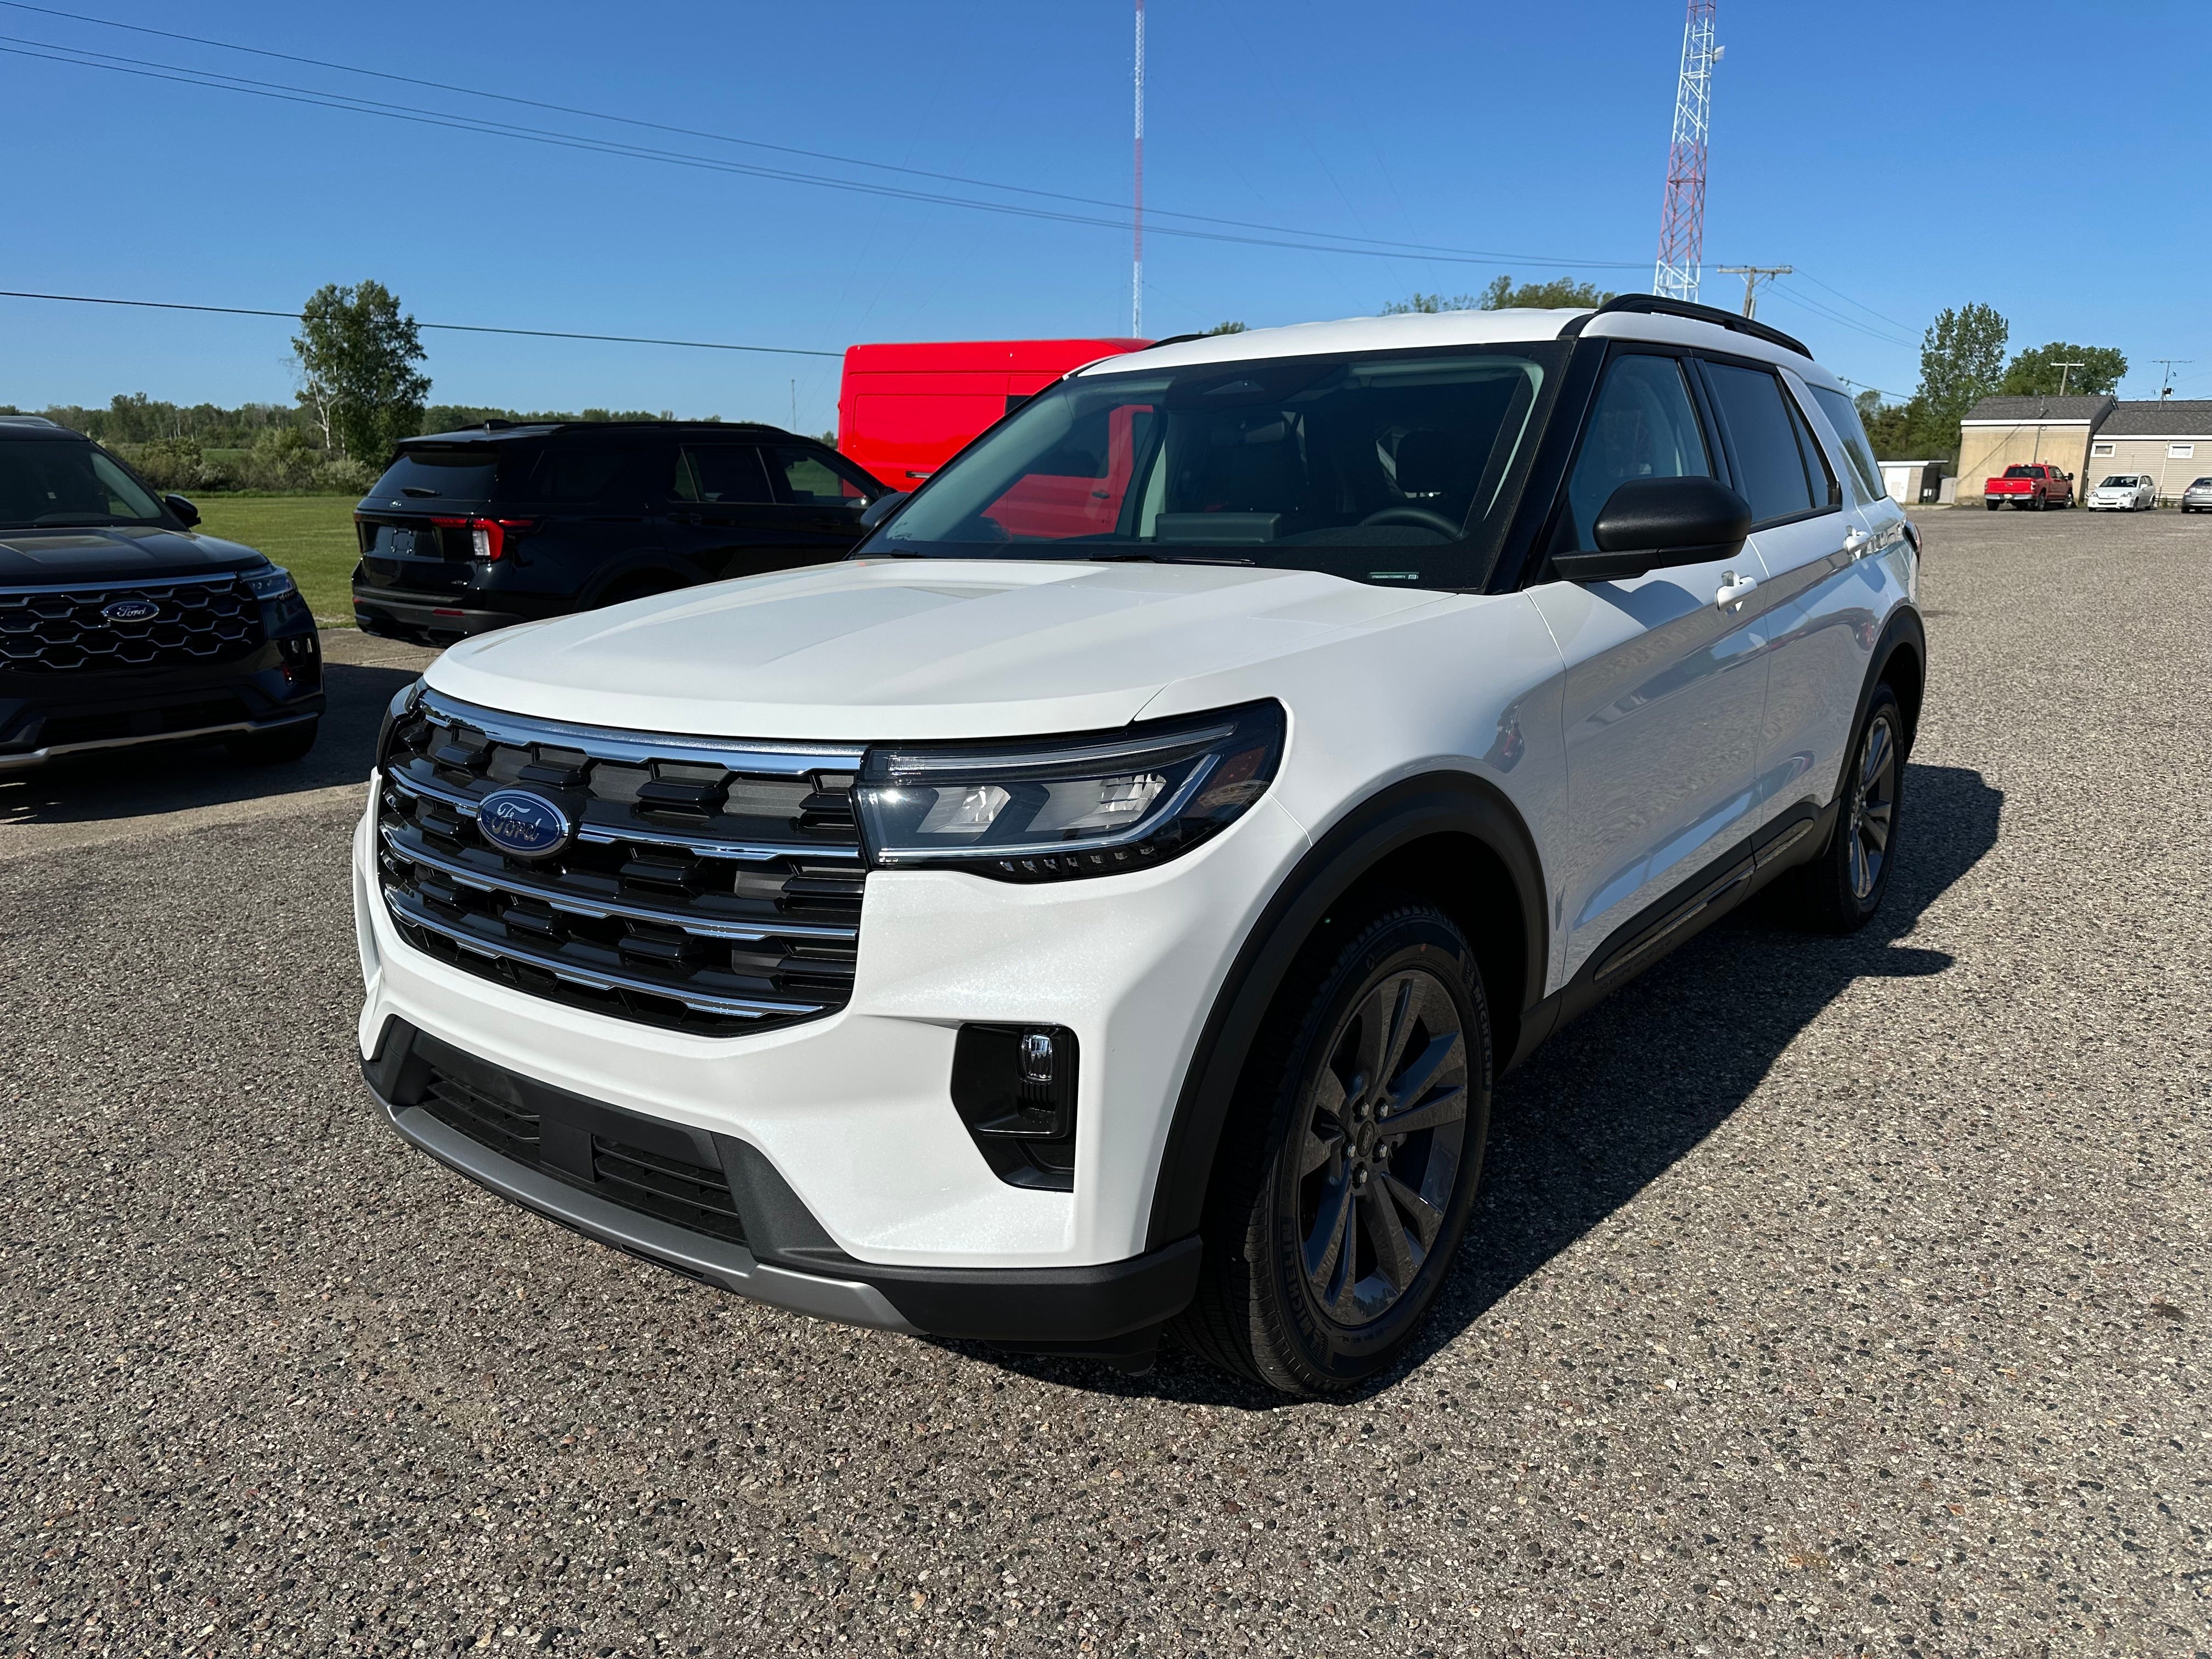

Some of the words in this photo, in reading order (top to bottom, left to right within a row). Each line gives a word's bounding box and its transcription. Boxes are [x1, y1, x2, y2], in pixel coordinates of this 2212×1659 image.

[117, 605, 146, 617] Ford
[491, 802, 543, 842] Ford
[1472, 985, 1492, 1086] MICHELIN
[1282, 1223, 1314, 1336] MICHELIN
